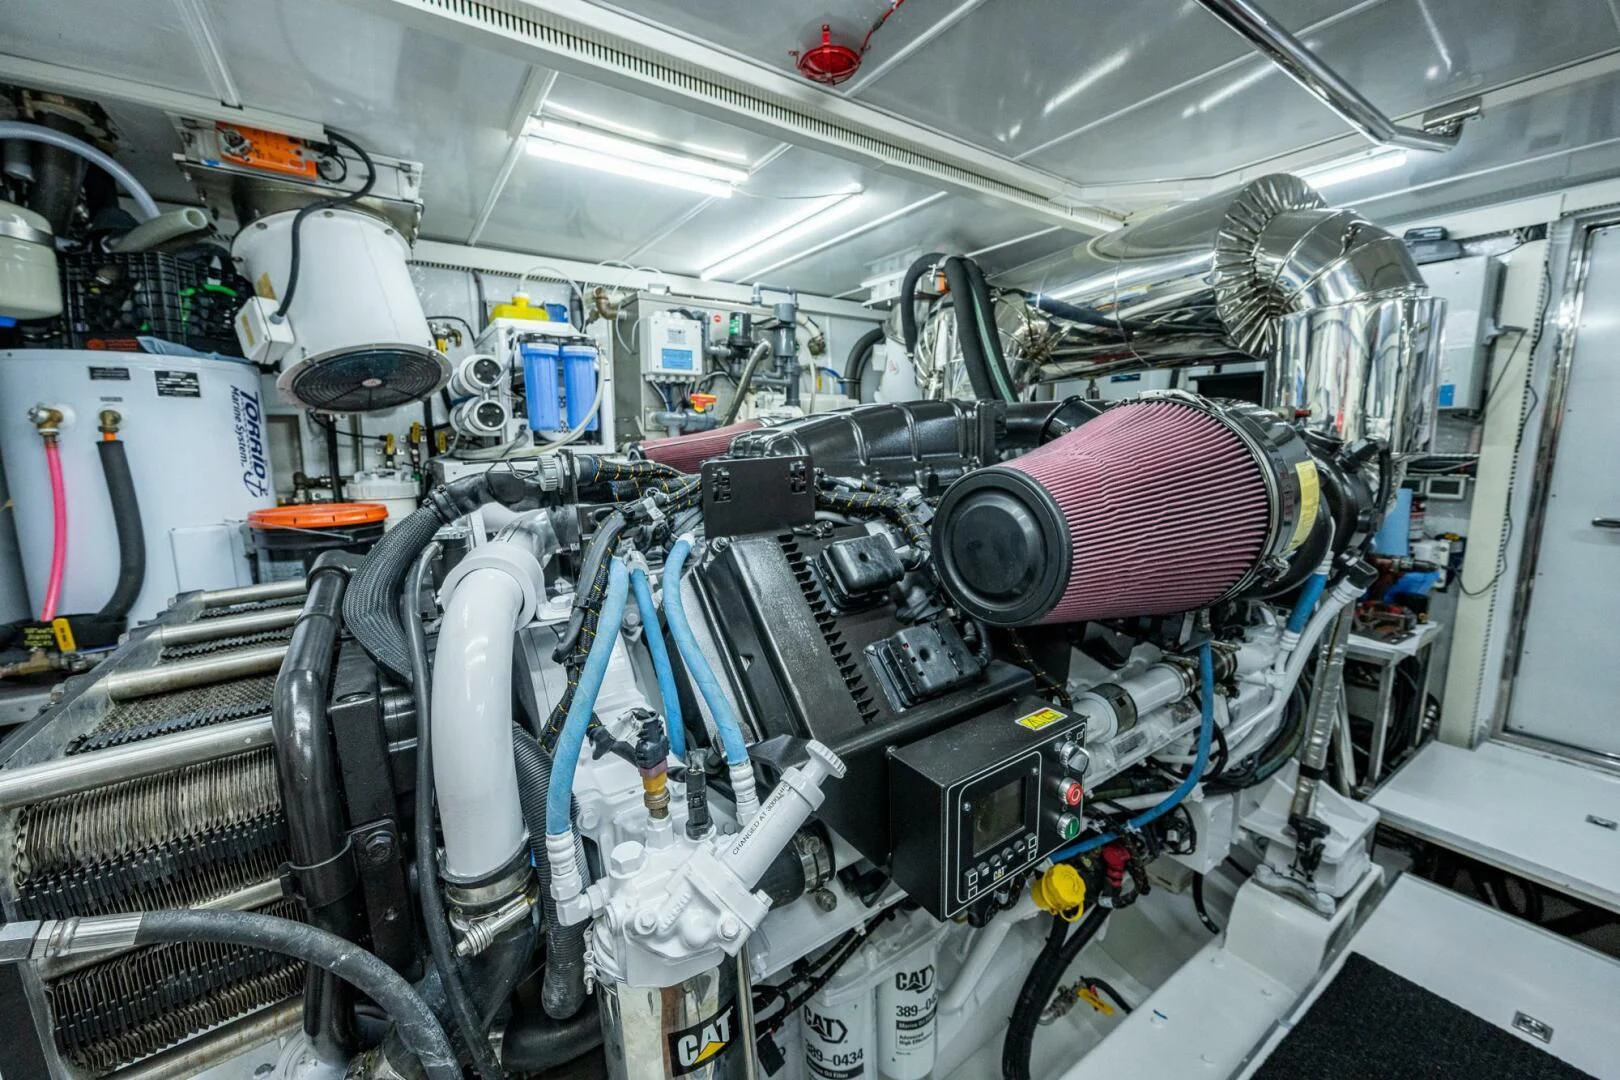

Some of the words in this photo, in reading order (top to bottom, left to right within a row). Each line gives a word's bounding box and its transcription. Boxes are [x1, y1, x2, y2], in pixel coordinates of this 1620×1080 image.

[230, 384, 242, 422] Marine
[234, 424, 248, 463] System
[240, 390, 266, 480] TORRID
[732, 821, 760, 855] CHANGED
[993, 865, 1007, 881] CAT
[895, 965, 934, 993] CAT
[677, 1005, 734, 1067] CAT
[804, 1004, 845, 1043] CAT
